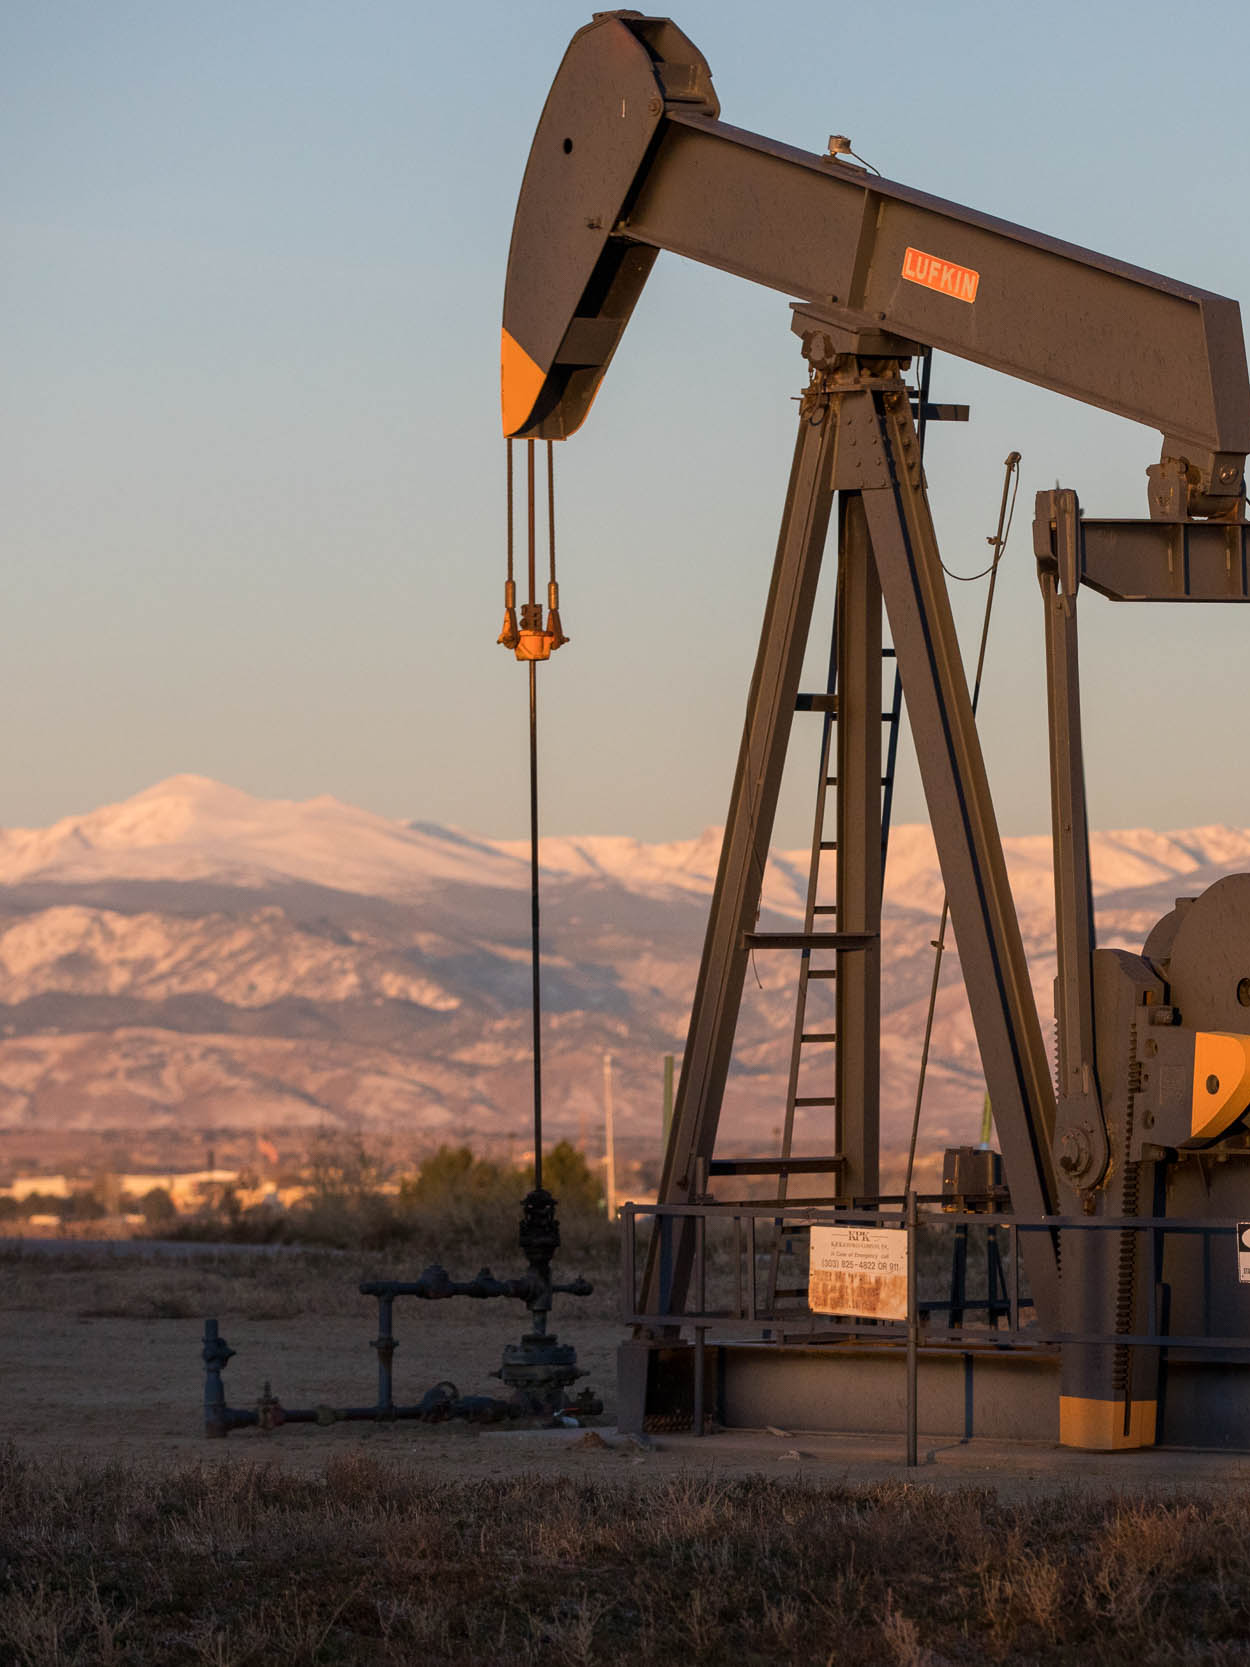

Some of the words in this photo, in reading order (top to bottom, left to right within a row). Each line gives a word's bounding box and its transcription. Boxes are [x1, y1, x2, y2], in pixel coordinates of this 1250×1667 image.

[905, 251, 976, 299] LUFKIN
[848, 1230, 870, 1241] KPK
[822, 1259, 839, 1268] (303)
[878, 1261, 888, 1270] OR
[889, 1262, 899, 1272] 911
